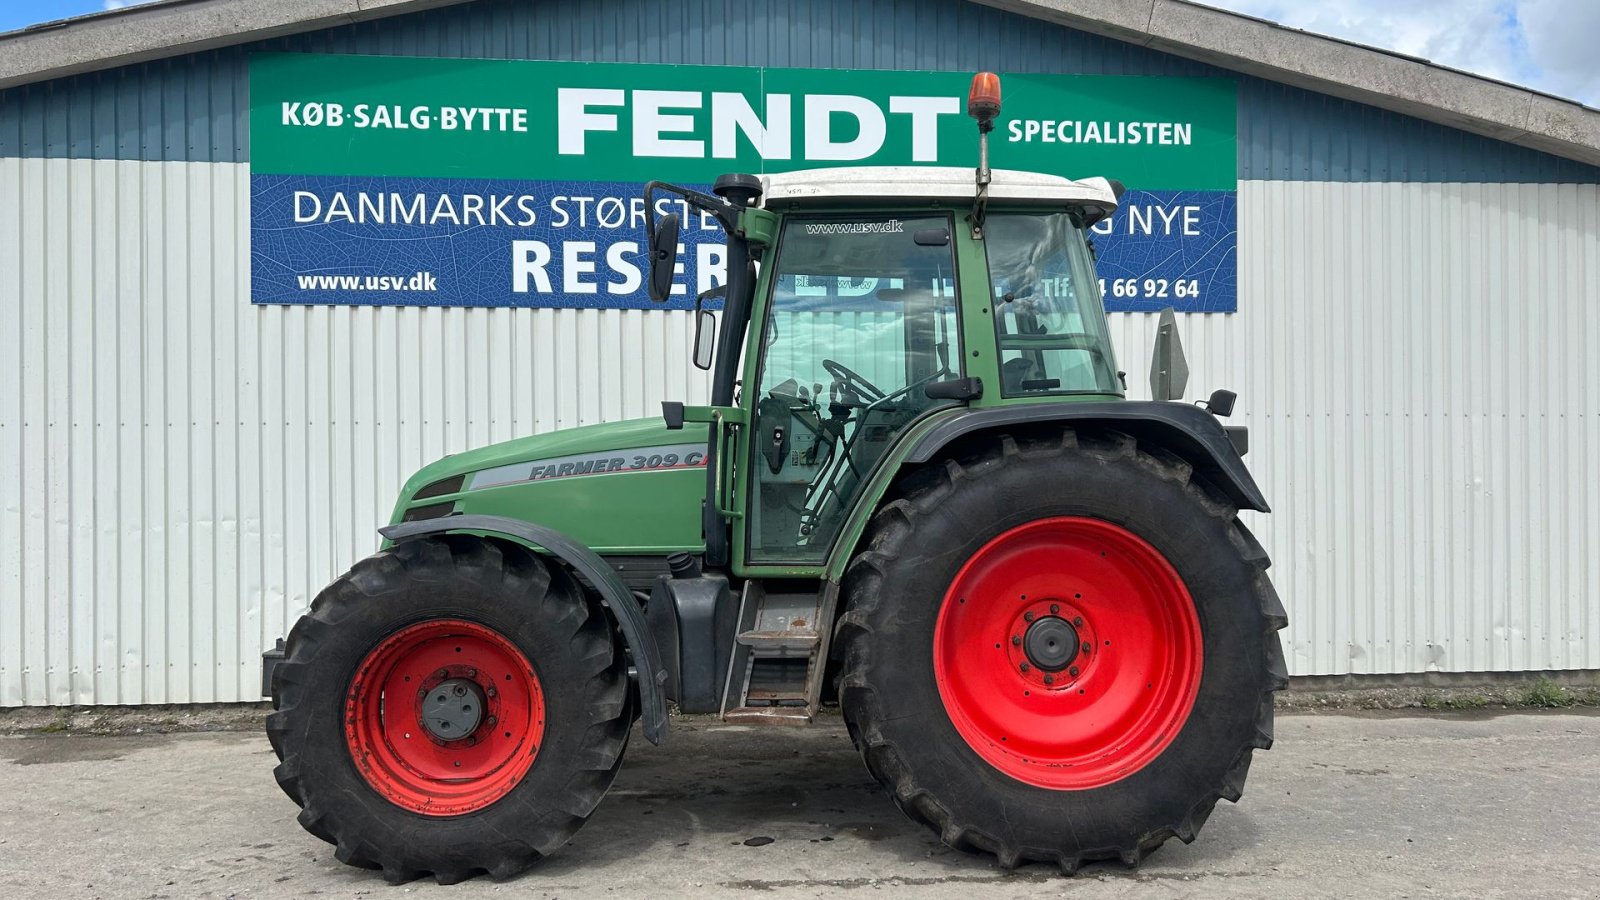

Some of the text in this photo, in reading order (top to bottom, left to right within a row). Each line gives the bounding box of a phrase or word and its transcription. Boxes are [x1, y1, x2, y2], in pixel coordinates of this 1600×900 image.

[558, 88, 961, 163] FENDT
[1007, 119, 1192, 146] SPECIALISTEN
[293, 190, 536, 227] DANMARKS
[1128, 205, 1201, 236] NYE
[805, 218, 905, 235] www.usv.dk
[297, 270, 438, 293] www.usv.dk
[1112, 278, 1139, 298] 66
[1143, 278, 1169, 298] 92
[1174, 278, 1200, 299] 64
[528, 457, 625, 481] FARMER
[630, 453, 679, 469] 309
